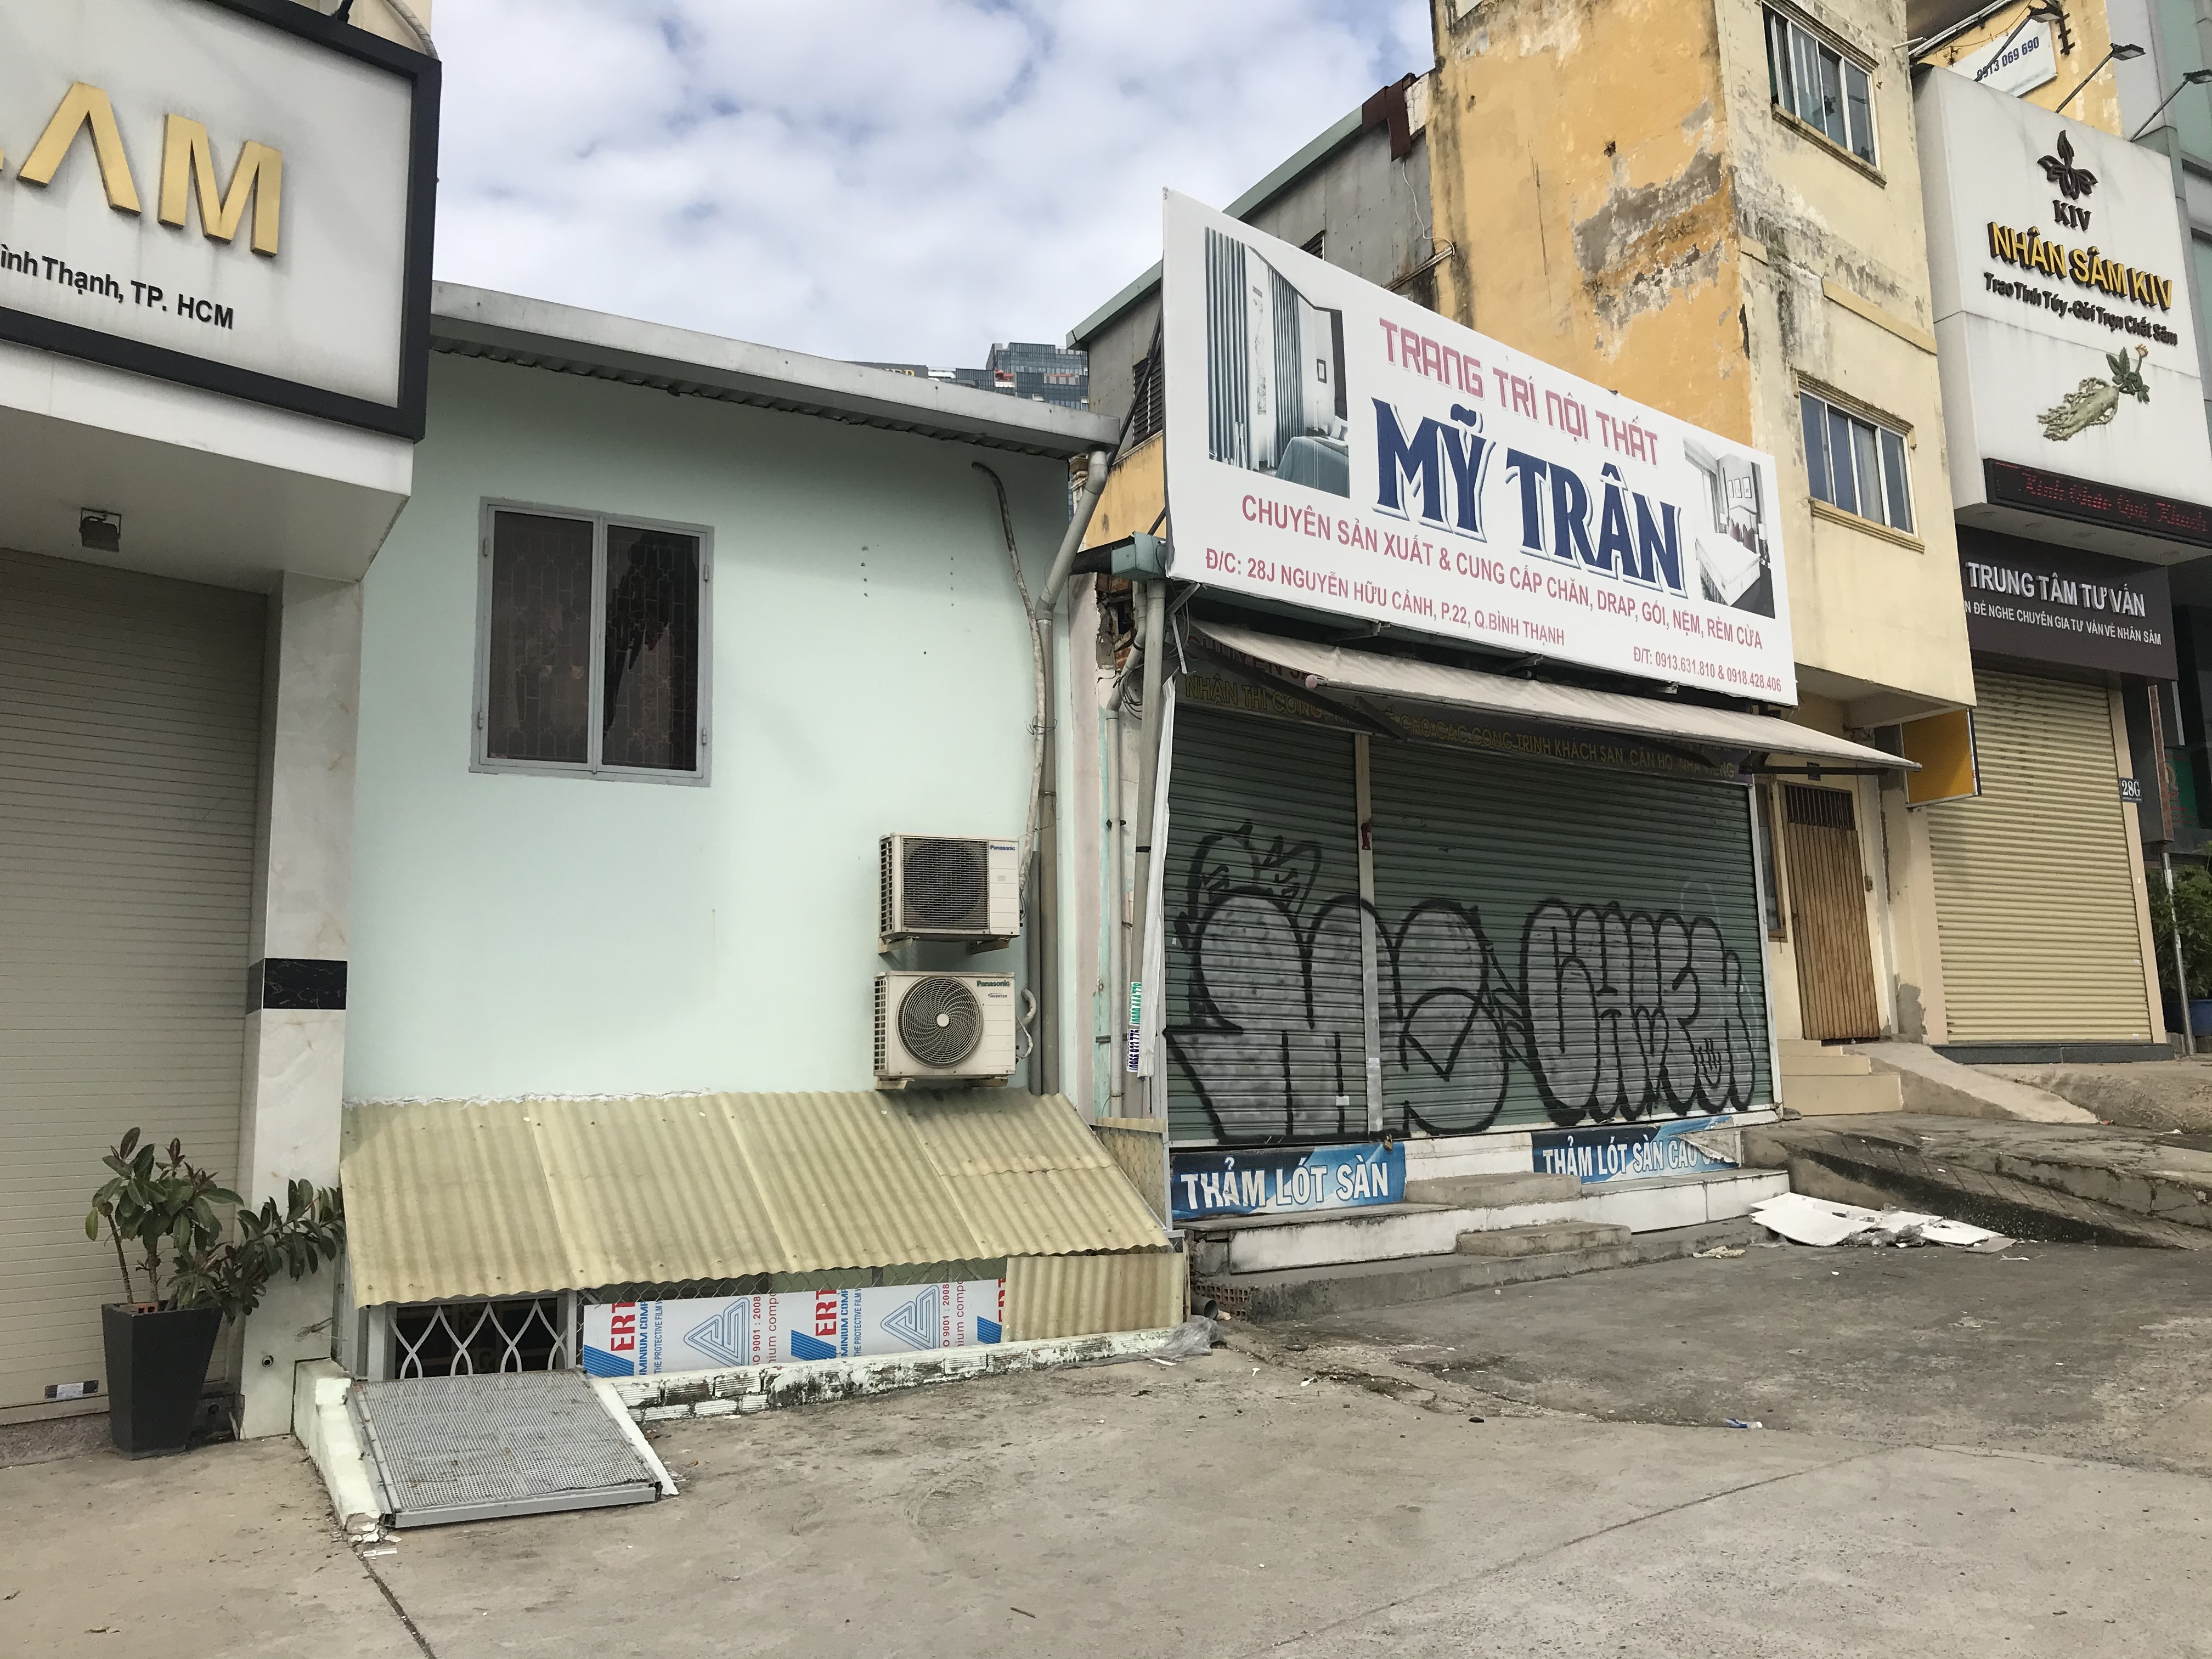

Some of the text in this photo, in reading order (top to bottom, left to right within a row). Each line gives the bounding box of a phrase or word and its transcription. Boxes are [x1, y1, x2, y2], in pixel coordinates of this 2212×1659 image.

[2002, 48, 2019, 67] 069
[2022, 36, 2039, 55] 690
[2052, 199, 2092, 232] KIV
[1987, 222, 2172, 311] NHÂN SÂM KIV
[42, 255, 123, 303] Thạnh,
[131, 281, 167, 312] TP.
[177, 294, 234, 329] HCM
[1984, 272, 2014, 297] Trao
[2096, 306, 2124, 332] Trọn
[2124, 315, 2152, 338] Chất
[2153, 323, 2178, 346] Sâm
[1379, 317, 1658, 467] TRANG TRÍ NỘI THẤT
[1371, 397, 1688, 599] MỸ TRÂN
[1242, 494, 1763, 650] CHUYÊN SẢN XUẤT & CUNG CẤP CHĂN, DRAP, GỐI, NỆM, RÈM CỬA
[1965, 562, 2145, 617] TRUNG TÂM TƯ VẤN
[1205, 548, 1565, 646] Đ/C: 28J NGUYỄN HỮU CẢNH, P.22, Q.BÌNH THẠNH
[1988, 604, 2015, 621] NGHE
[2017, 609, 2053, 627] CHUYÊN
[2055, 616, 2070, 631] GIA
[2070, 618, 2084, 632] TƯ
[2086, 618, 2104, 636] VẤN
[2117, 626, 2142, 642] NHÂN
[2143, 629, 2162, 645] SÂM
[1633, 646, 1781, 692] Đ/T: 0913.631.810 & 0918.428.406
[1185, 674, 1238, 706] NHẬN
[1242, 684, 1267, 710] THI
[1435, 718, 1468, 744] CÁC
[1471, 724, 1513, 750] CÔNG
[1516, 730, 1550, 755] TRÌNH
[1554, 736, 1597, 761] KHÁCH
[1630, 747, 1655, 768] CĂN
[2121, 780, 2141, 797] 28G
[1543, 1135, 1593, 1176] THẢM
[1598, 1136, 1627, 1175] LÓT
[1633, 1135, 1663, 1172] SÀN
[1180, 1155, 1389, 1210] THẢM LÓT SÀN
[654, 1306, 663, 1320] FILM
[753, 1296, 761, 1319] 2008
[854, 1293, 862, 1306] FILM
[942, 1283, 950, 1306] 2008
[654, 1322, 663, 1360] PROTECTIVE
[753, 1329, 761, 1352] 9001
[854, 1307, 862, 1345] PROTECTIVE
